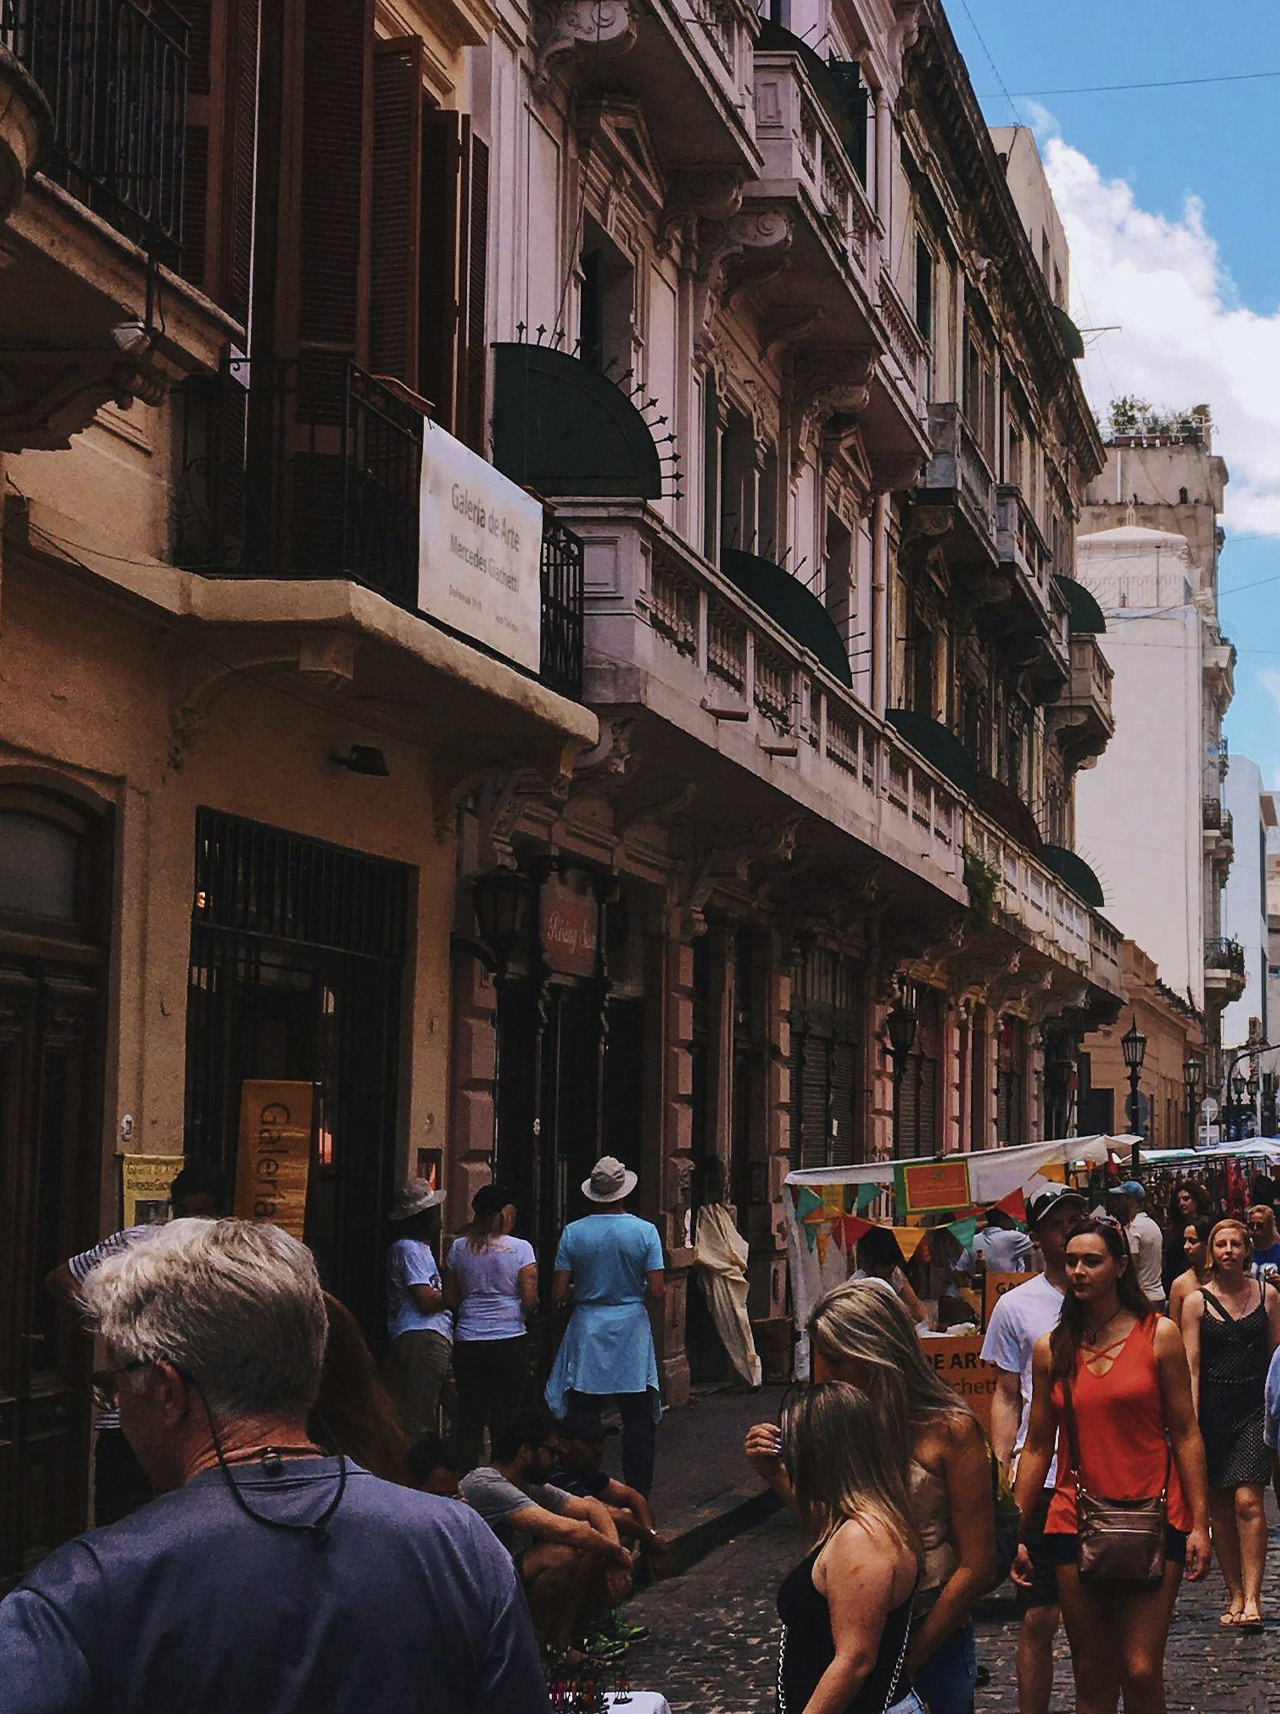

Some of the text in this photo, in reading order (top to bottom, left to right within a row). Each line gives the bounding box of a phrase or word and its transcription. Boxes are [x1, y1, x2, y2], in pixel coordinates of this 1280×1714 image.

[451, 483, 521, 553] Galería de Arte
[450, 534, 487, 573] Mercedes
[949, 1352, 998, 1369] ART
[947, 1377, 998, 1395] chett
